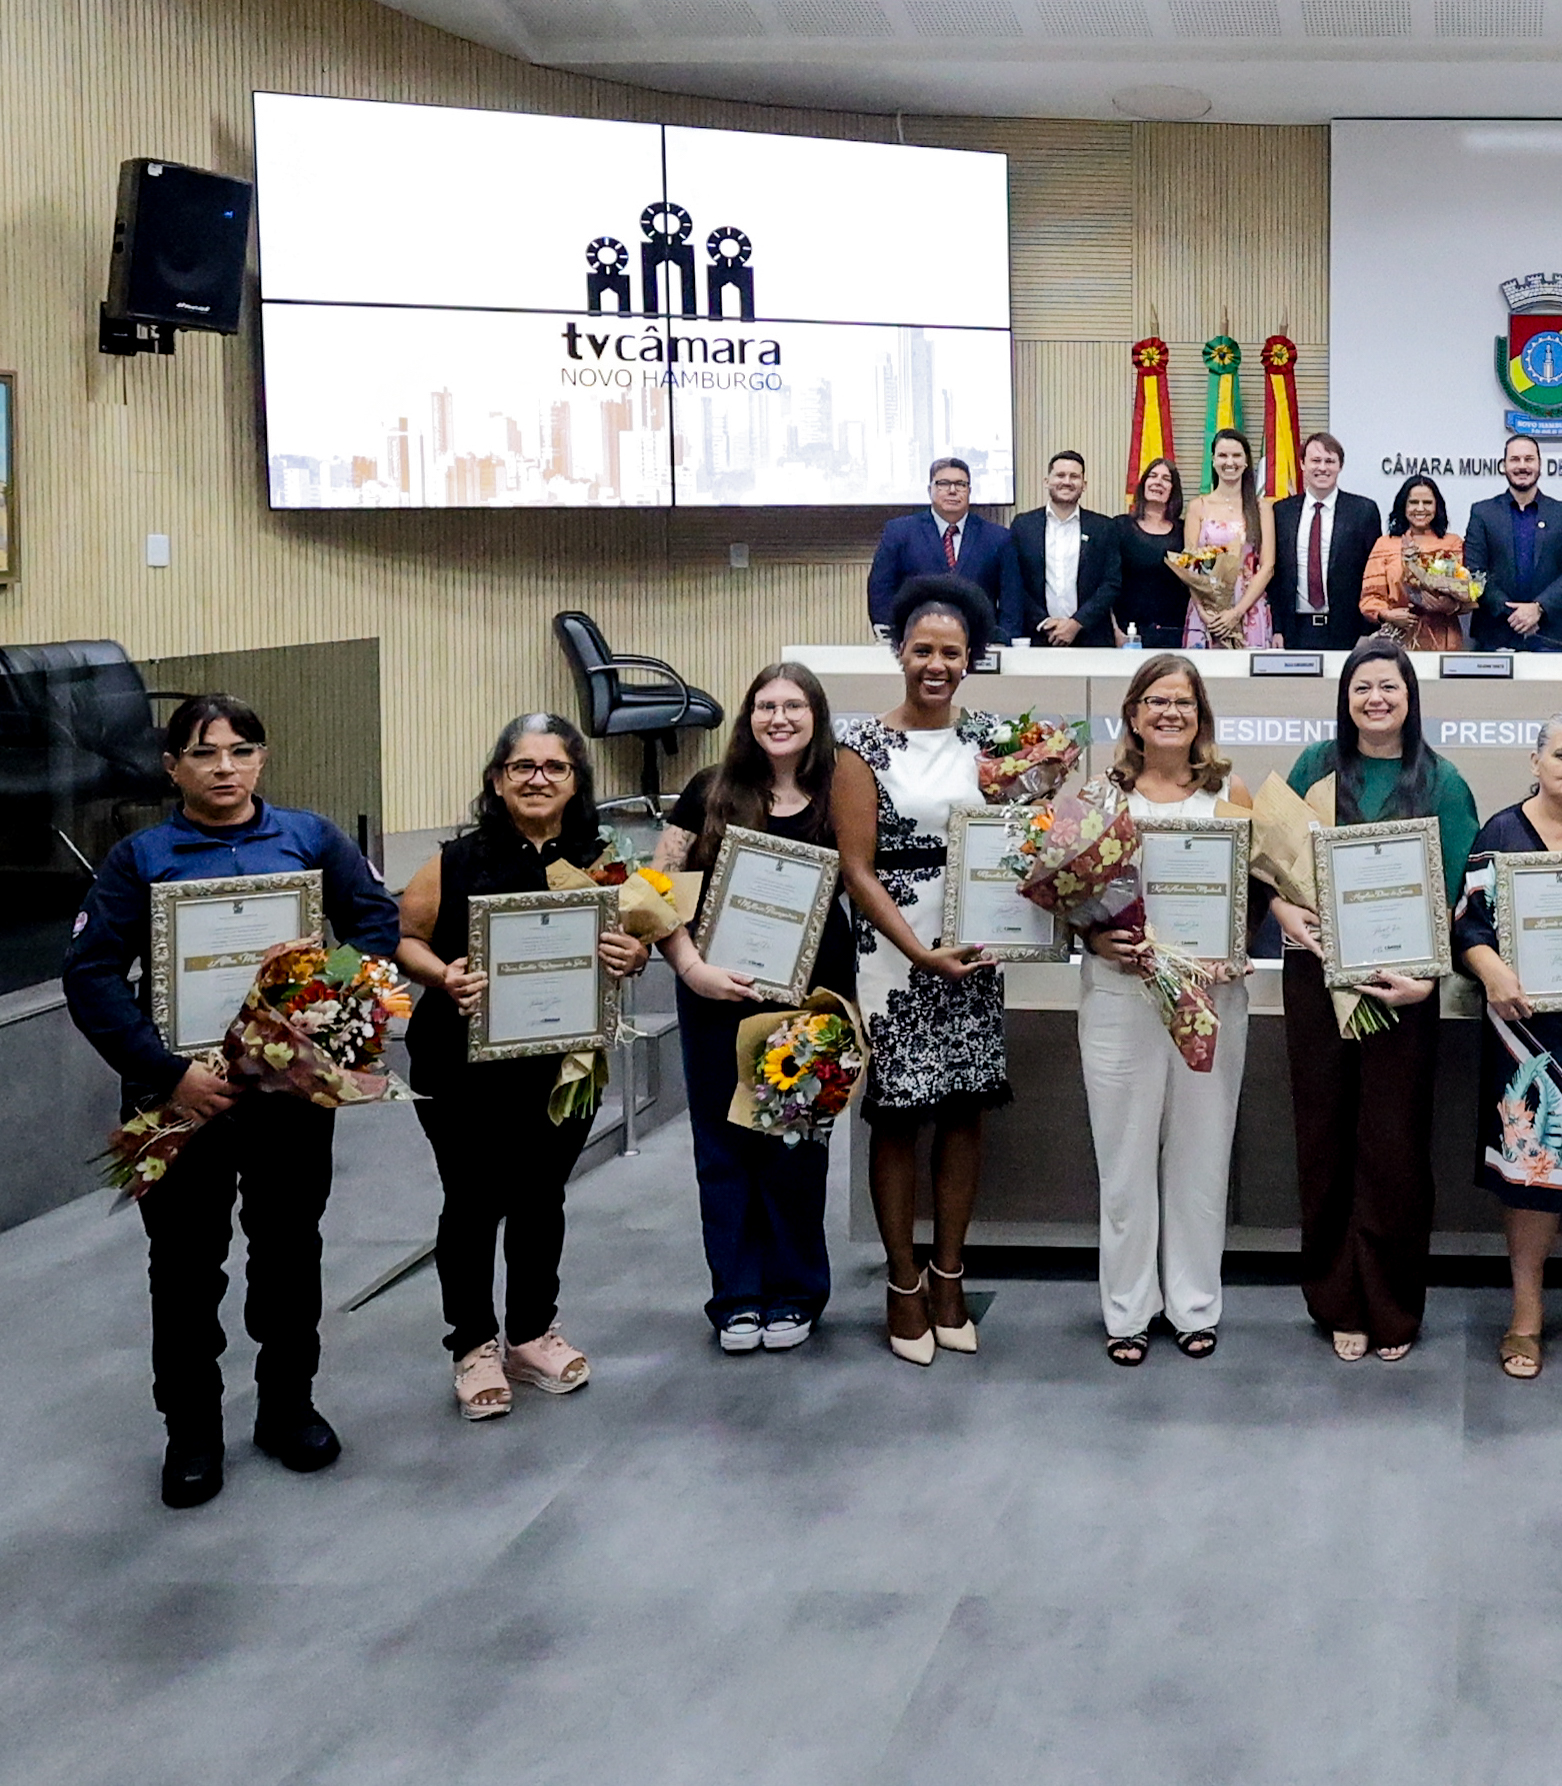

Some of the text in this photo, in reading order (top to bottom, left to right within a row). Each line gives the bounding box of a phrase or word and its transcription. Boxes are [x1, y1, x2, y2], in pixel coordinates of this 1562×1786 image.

[561, 322, 782, 366] tvcâmara
[561, 367, 783, 391] NOVO HAMBURGO
[1381, 452, 1455, 476] CÂMARA
[1459, 457, 1506, 476] MUNIC
